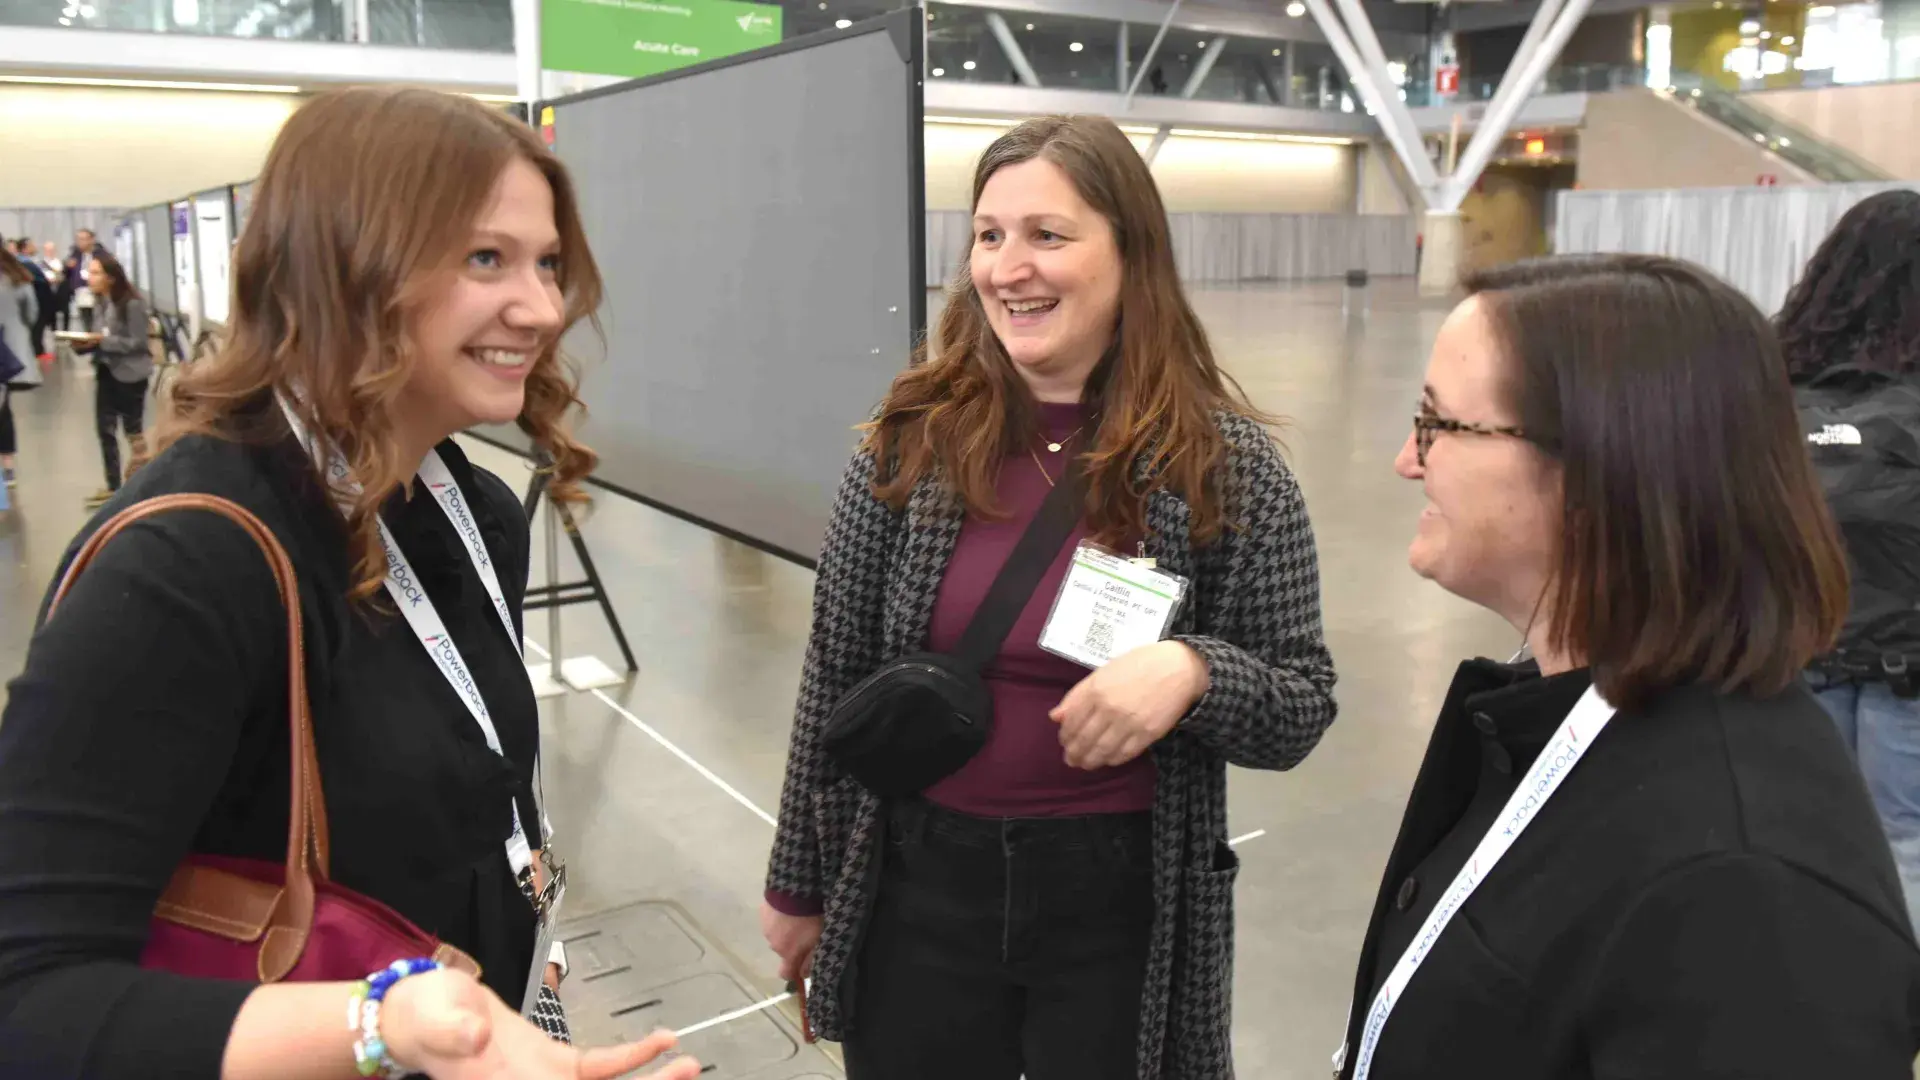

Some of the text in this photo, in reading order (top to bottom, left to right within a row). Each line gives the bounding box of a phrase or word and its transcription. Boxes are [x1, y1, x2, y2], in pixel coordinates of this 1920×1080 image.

[633, 40, 700, 57] Acute Care
[376, 523, 423, 608] erback
[444, 487, 489, 569] Powerback
[1105, 581, 1131, 598] Caitlin
[439, 638, 488, 719] Powerback
[1503, 744, 1578, 837] Powerback
[1412, 877, 1475, 965] Powerback
